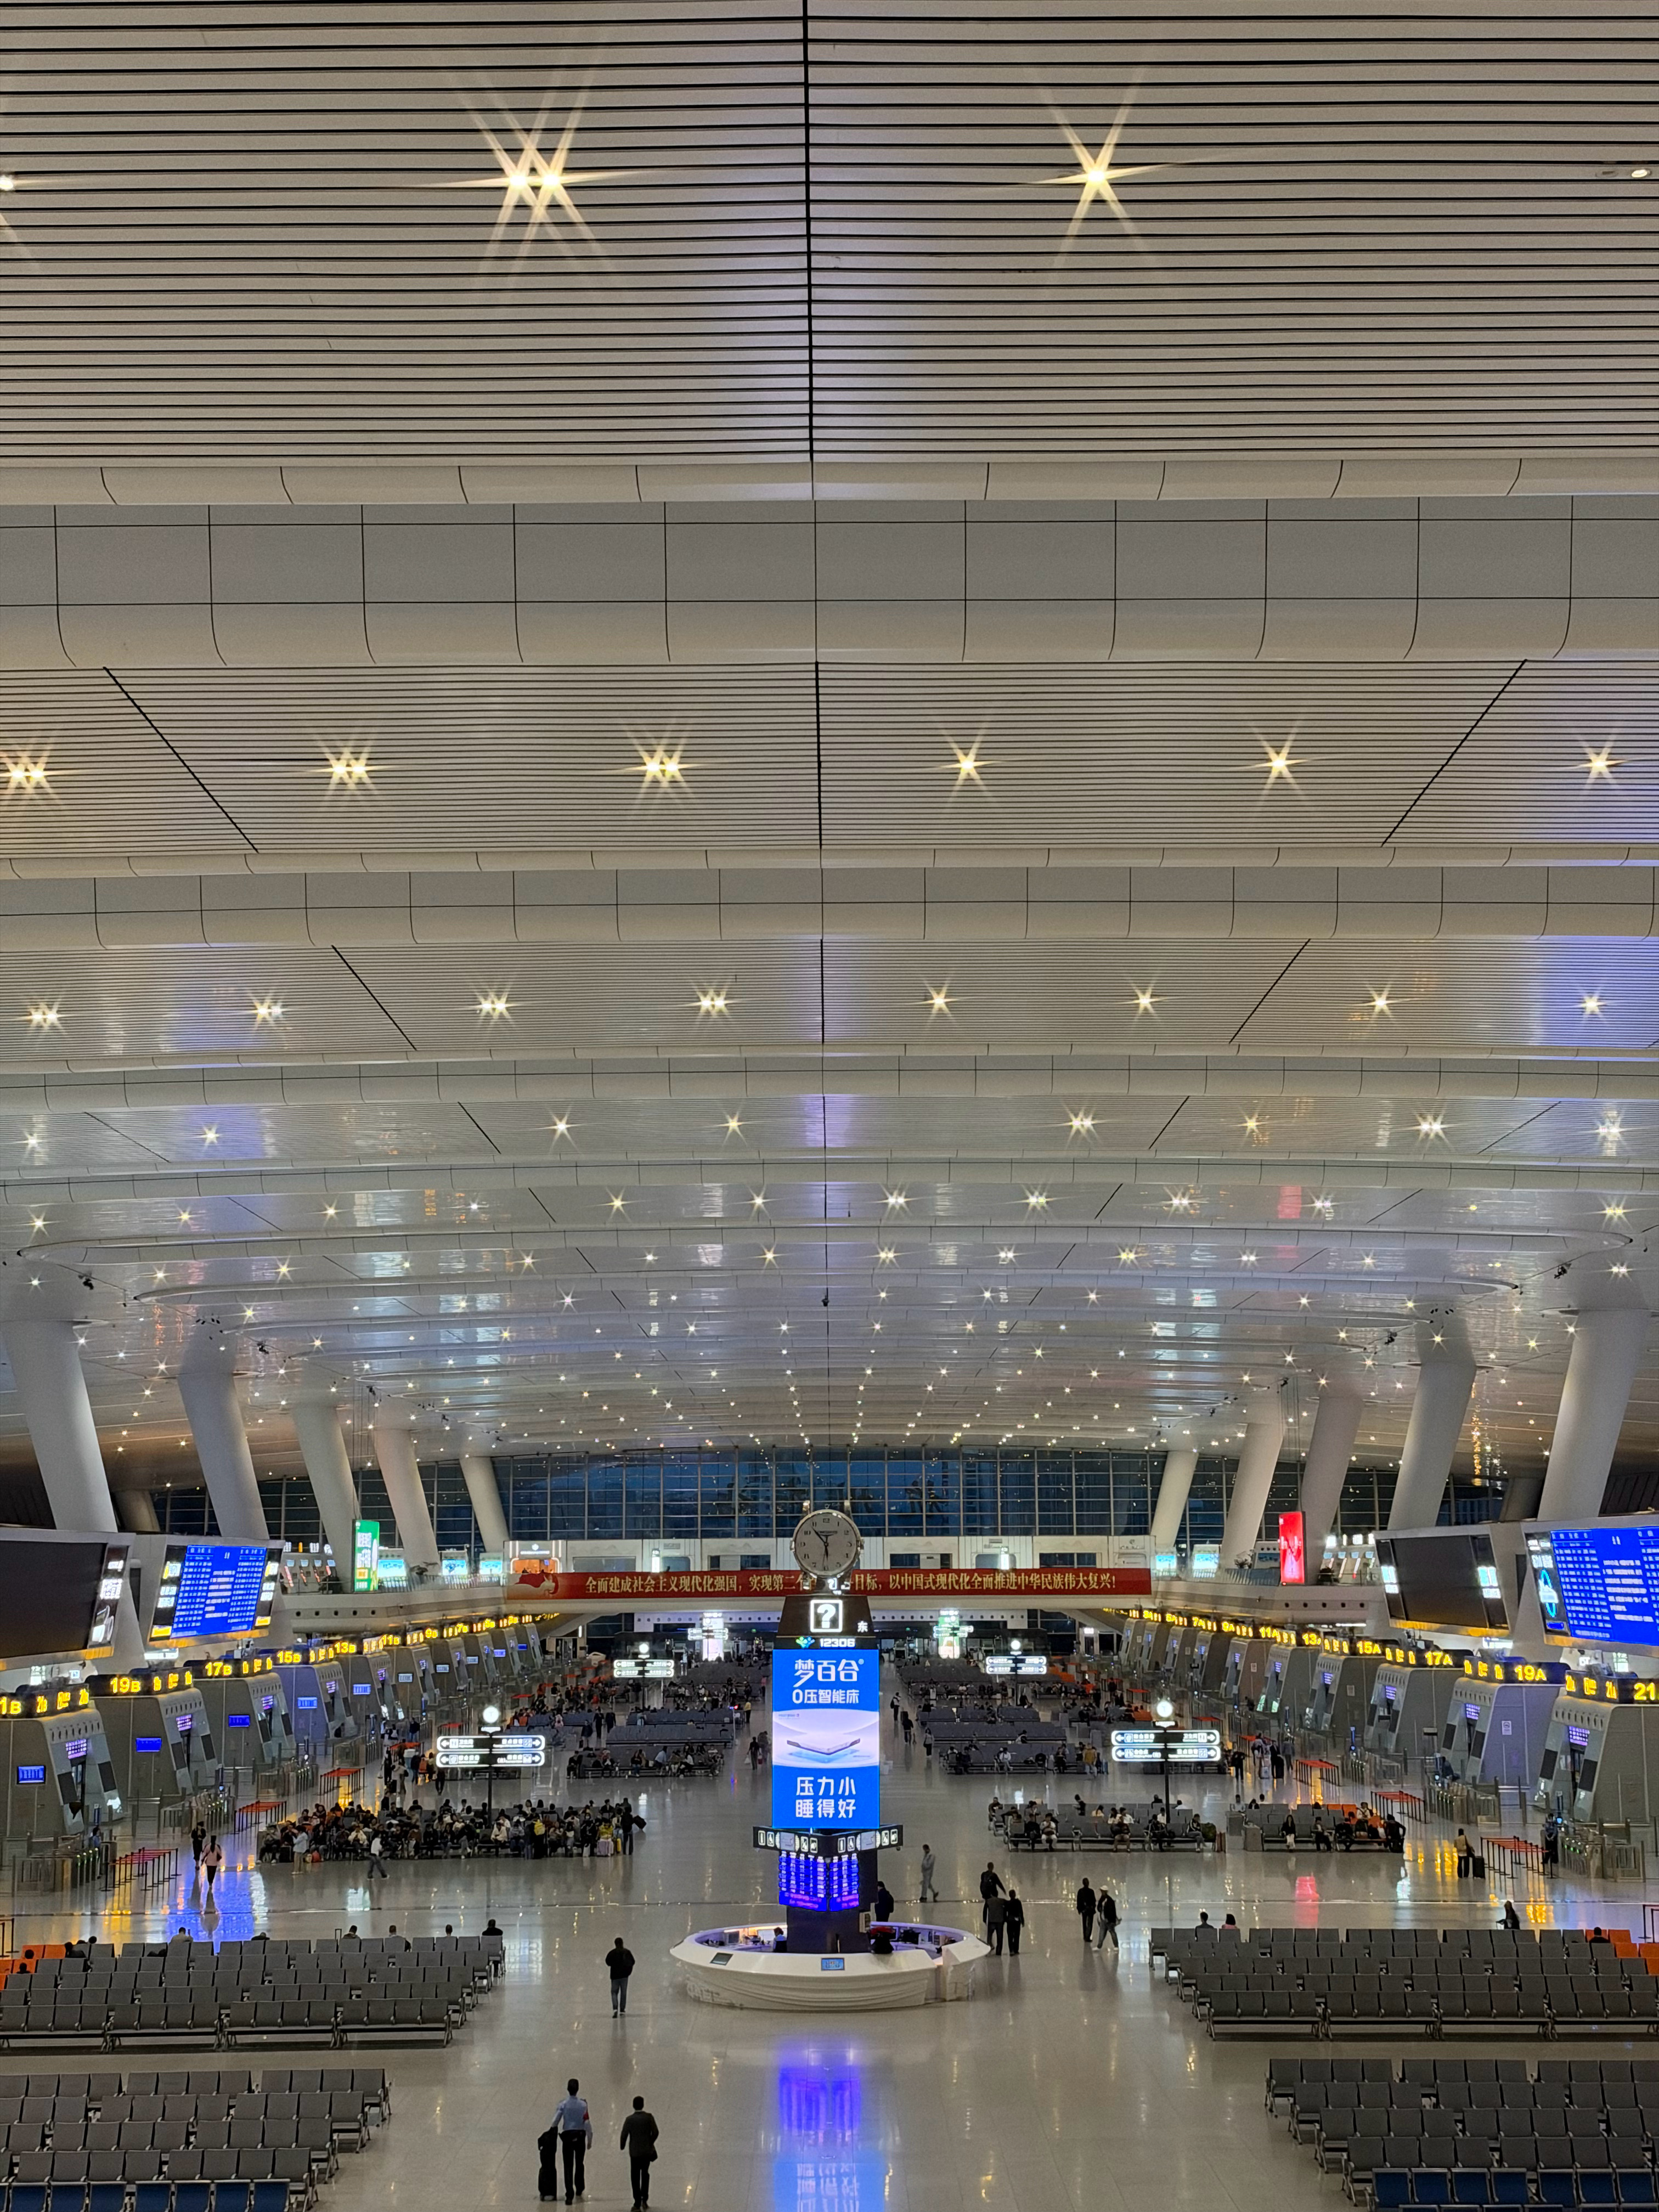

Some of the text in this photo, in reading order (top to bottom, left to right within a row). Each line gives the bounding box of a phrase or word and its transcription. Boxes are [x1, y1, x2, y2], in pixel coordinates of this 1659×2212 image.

[585, 1572, 1116, 1593] 全面建成社会主义现代化强国，实现第二个目标，以中国式现代化全面推进中华民族伟大复兴！
[857, 1621, 868, 1633] 东
[1259, 1626, 1279, 1638] 11A
[335, 1641, 356, 1654] 13B
[820, 1638, 855, 1647] 12306
[1356, 1640, 1381, 1654] 15A
[277, 1650, 301, 1663] 15B
[1425, 1651, 1453, 1666] 17A
[205, 1661, 233, 1677] 17B
[793, 1659, 860, 1688] 梦百合
[1515, 1664, 1547, 1681] 19A
[110, 1677, 141, 1694] 19B
[1634, 1682, 1659, 1701] 21
[792, 1689, 860, 1704] 0压智能床
[796, 1776, 856, 1796] 压力小
[795, 1798, 856, 1819] 睡得好
